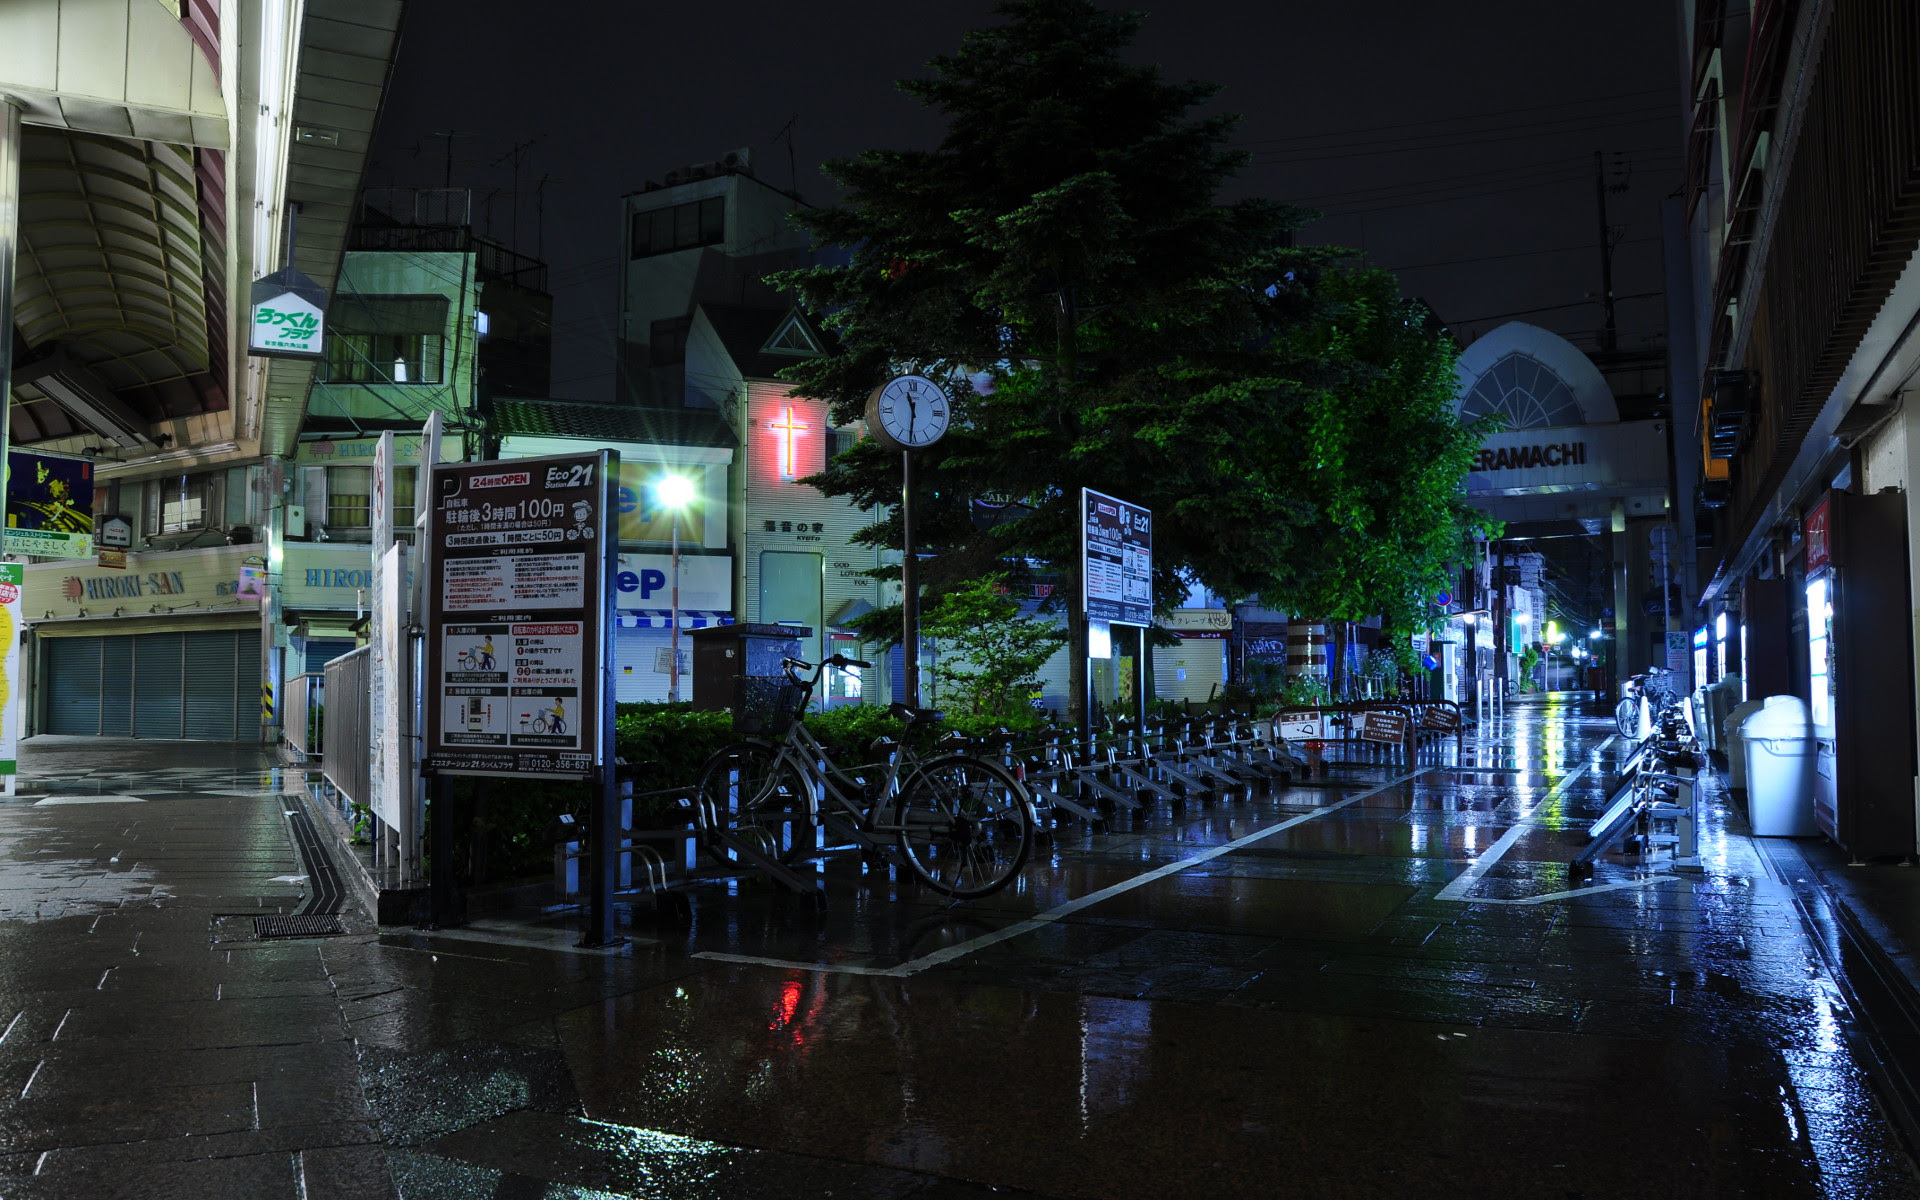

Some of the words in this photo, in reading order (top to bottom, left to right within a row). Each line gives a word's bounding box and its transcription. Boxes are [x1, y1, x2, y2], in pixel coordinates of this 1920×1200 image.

[256, 308, 320, 329] ろっくん
[278, 327, 318, 340] プラザ
[473, 474, 527, 488] 24時間OPEN
[547, 467, 569, 481] Eco
[567, 464, 594, 488] 21
[545, 481, 567, 489] Station
[446, 498, 468, 509] 自転車
[763, 520, 824, 534] 福音の家
[5, 530, 53, 538] エンジェルストリート
[85, 572, 185, 600] HIROKI-SAN
[532, 759, 589, 770] 0120-356-621
